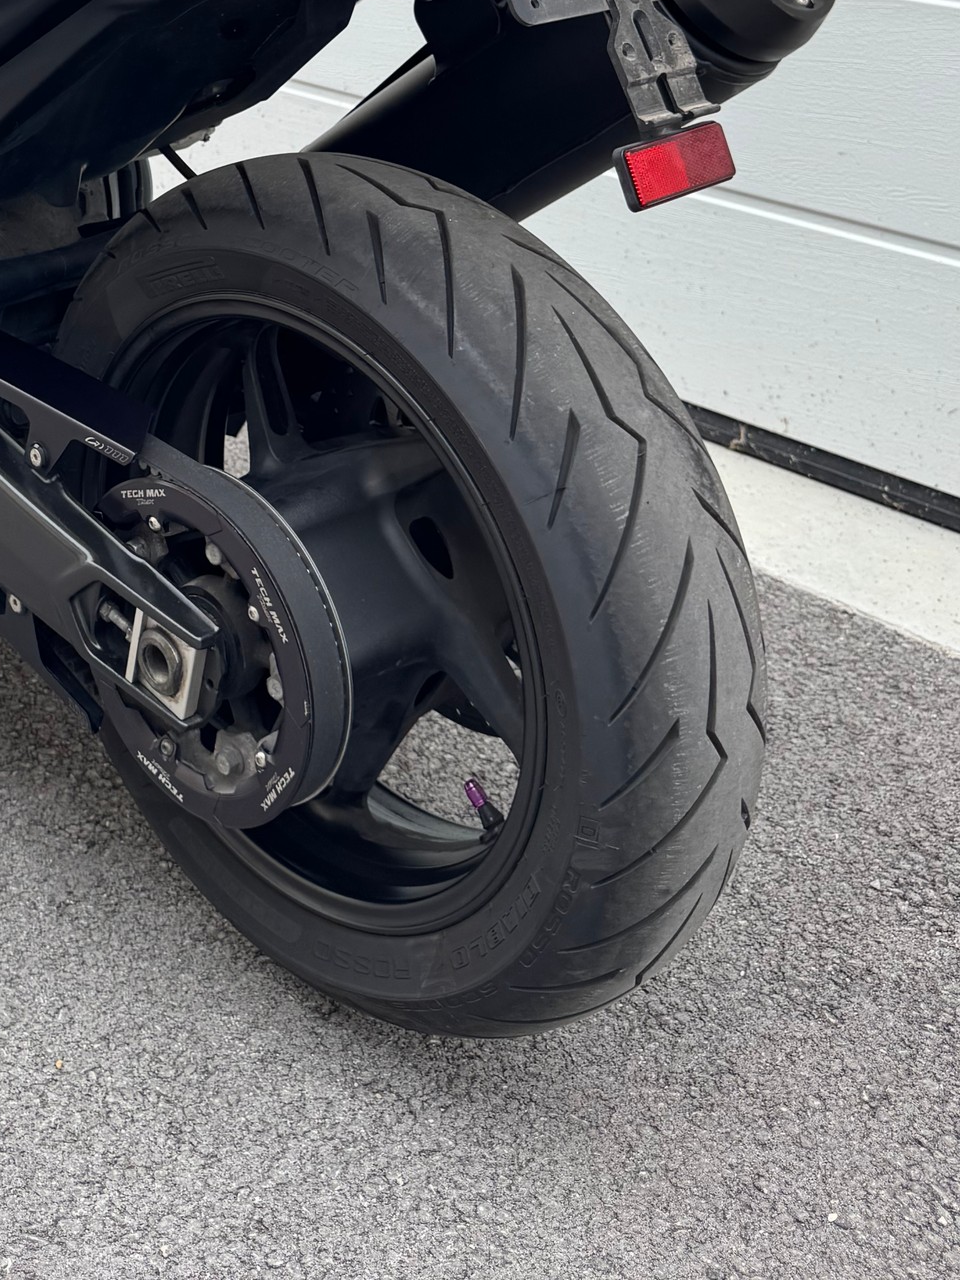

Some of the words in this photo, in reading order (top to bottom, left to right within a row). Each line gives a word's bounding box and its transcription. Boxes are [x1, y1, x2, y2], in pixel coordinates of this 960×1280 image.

[121, 489, 144, 499] TECH
[146, 488, 166, 498] MAX
[251, 567, 273, 607] TECH
[269, 611, 289, 644] MAX
[136, 750, 158, 775] MAX
[158, 773, 184, 803] TECH
[275, 767, 296, 794] TECH
[260, 788, 278, 812] MAX
[312, 940, 411, 980] ROSSO
